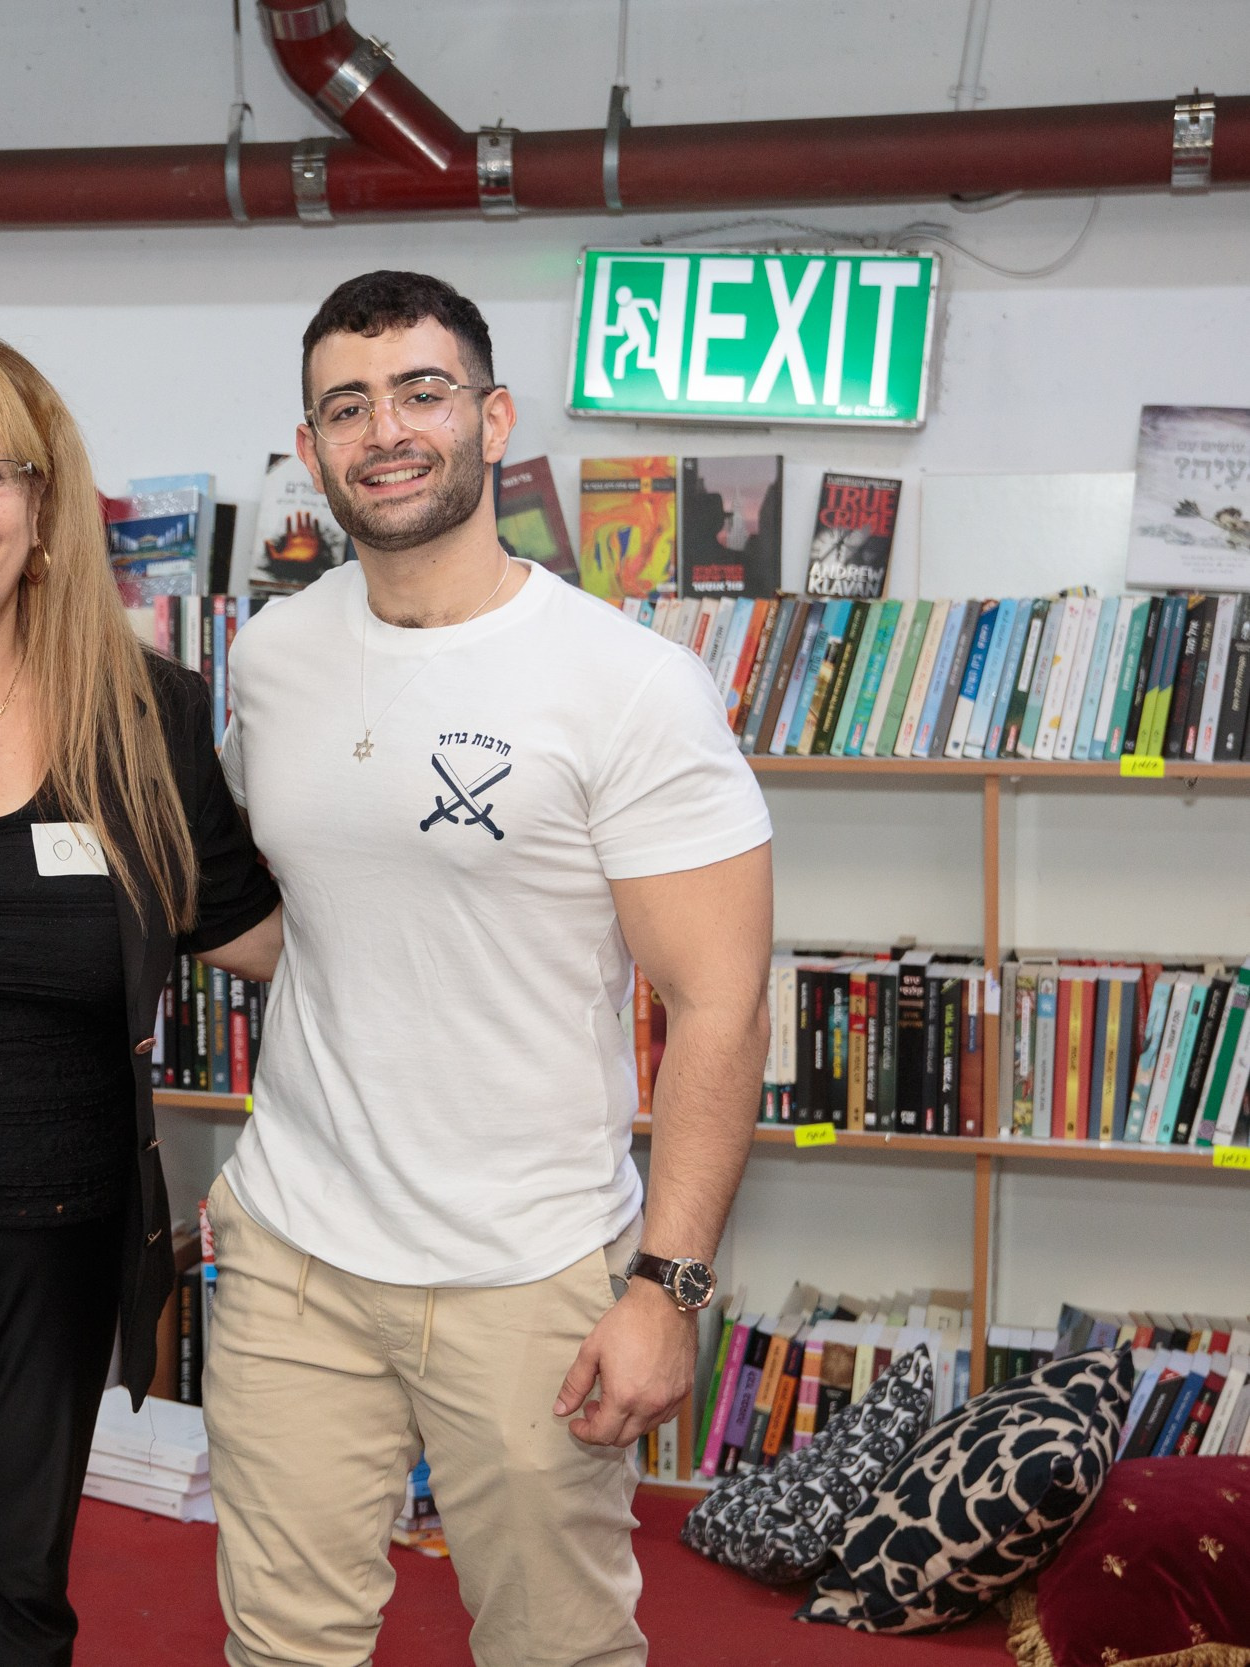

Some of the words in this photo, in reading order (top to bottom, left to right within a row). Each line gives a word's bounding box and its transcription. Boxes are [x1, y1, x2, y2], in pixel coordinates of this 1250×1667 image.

[686, 257, 922, 406] EXIT
[823, 484, 896, 513] TRUE
[818, 508, 893, 537] CRIME
[809, 561, 884, 584] ANDREW
[808, 577, 881, 598] KLAVAN
[438, 732, 469, 747] ברזל
[471, 733, 512, 757] חרבות
